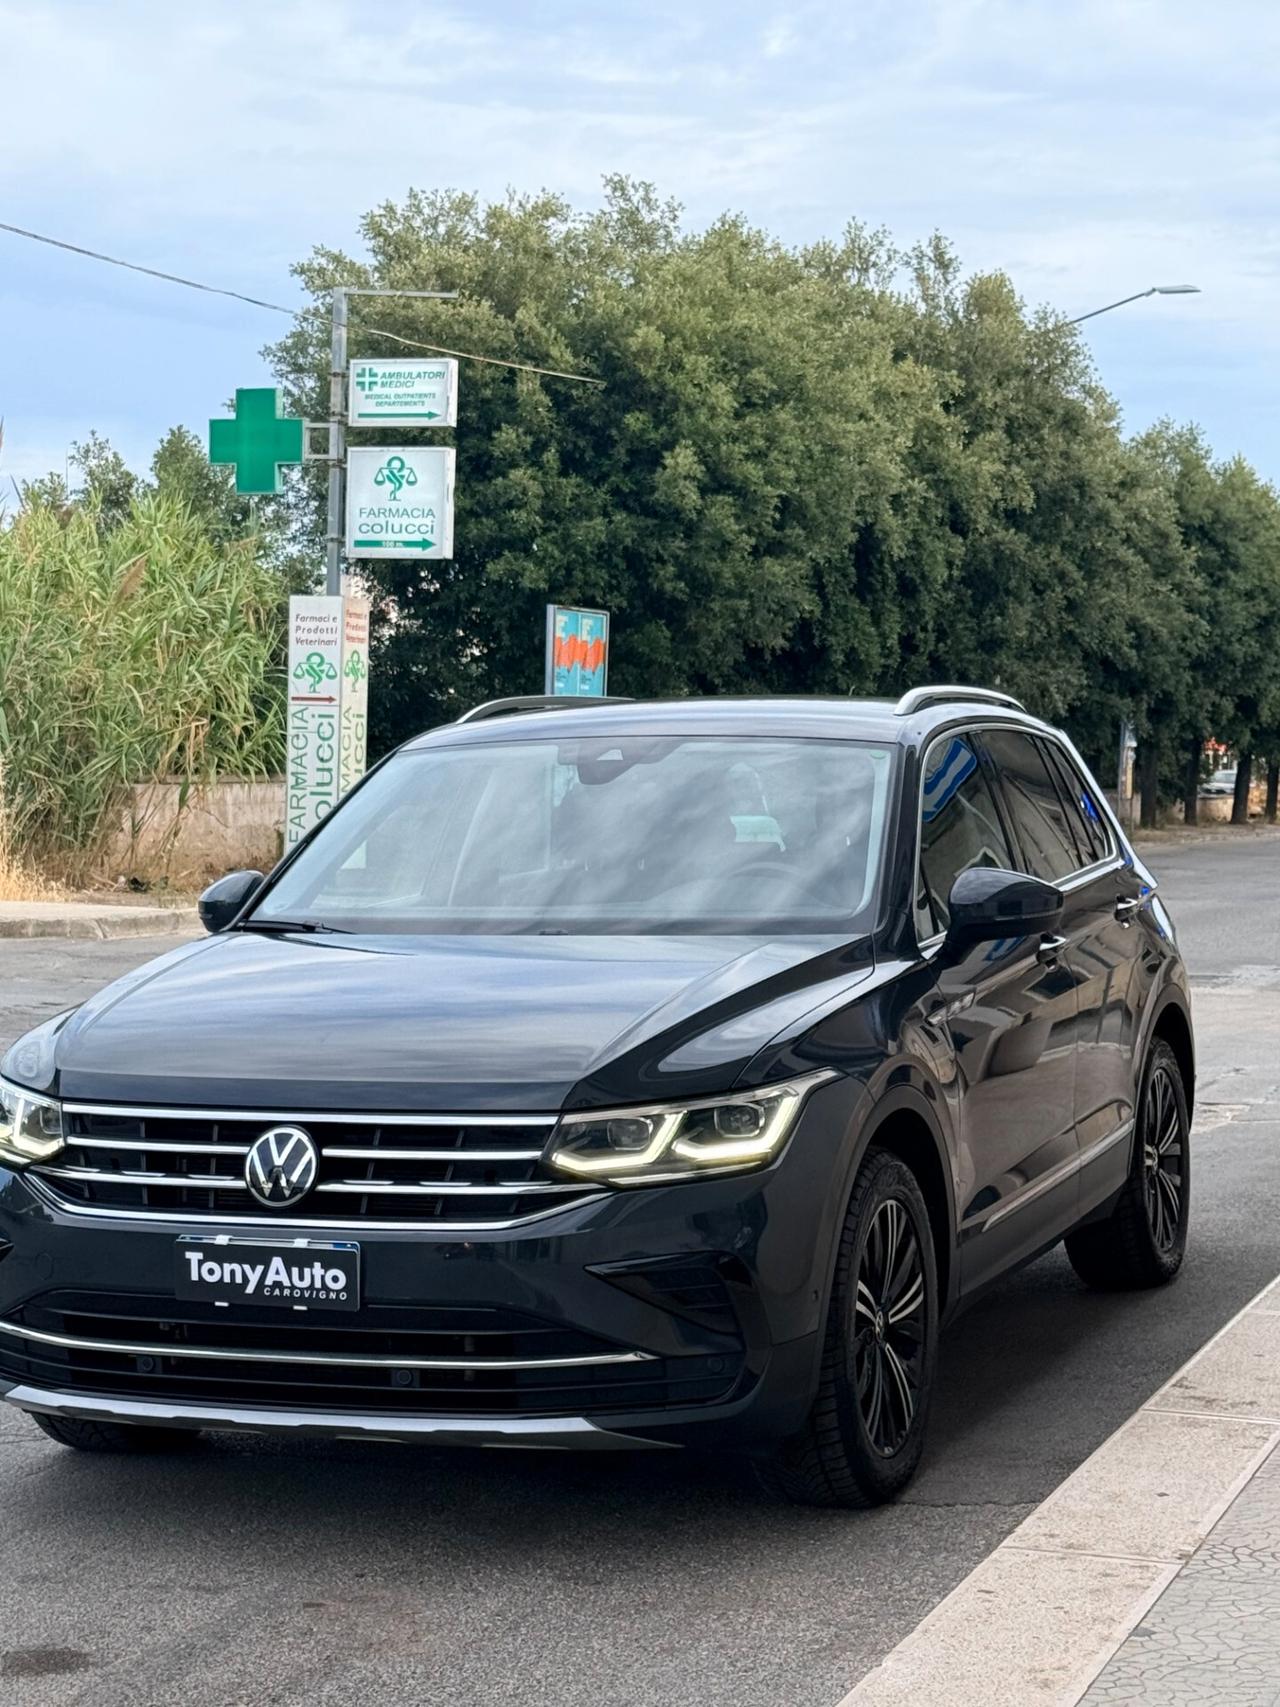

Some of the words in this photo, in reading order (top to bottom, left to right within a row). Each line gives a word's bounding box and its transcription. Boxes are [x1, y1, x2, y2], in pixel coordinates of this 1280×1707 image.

[380, 371, 446, 380] AMBULATORI
[380, 380, 416, 389] MEDICI
[359, 507, 436, 519] FARMACIA
[358, 520, 435, 535] colucci
[295, 613, 331, 623] Farmaci
[332, 615, 338, 623] e
[295, 625, 338, 635] Prodotti
[295, 636, 338, 647] Veterinari
[340, 706, 352, 793] MACIA
[309, 713, 335, 821] olucci
[289, 706, 309, 843] FARMACIA
[264, 1286, 348, 1301] CAROVIGNO
